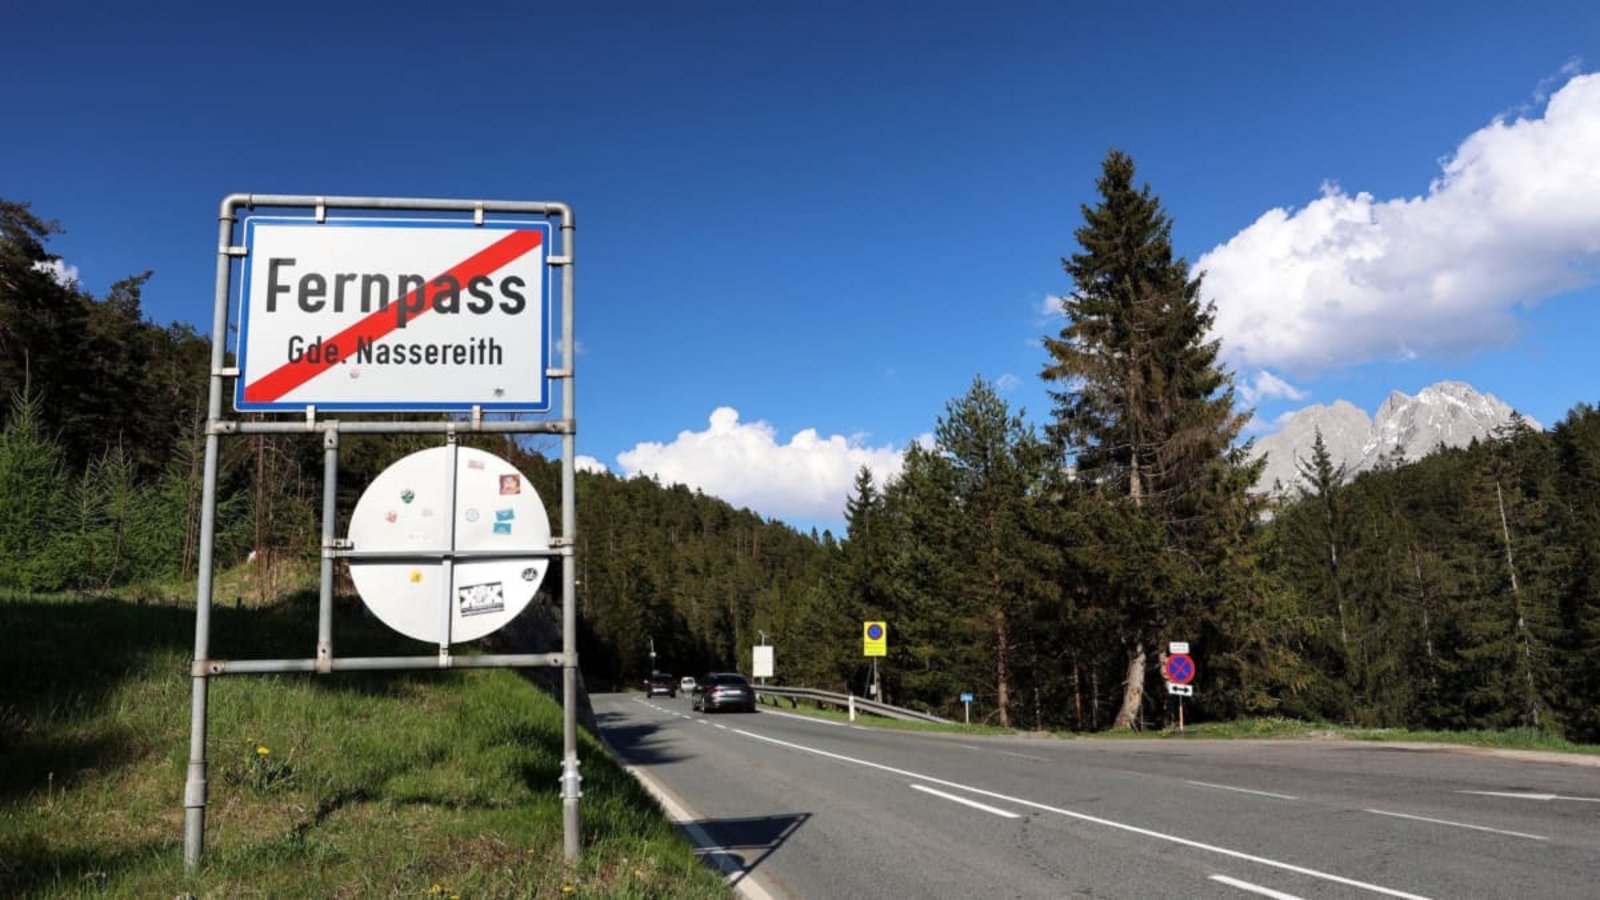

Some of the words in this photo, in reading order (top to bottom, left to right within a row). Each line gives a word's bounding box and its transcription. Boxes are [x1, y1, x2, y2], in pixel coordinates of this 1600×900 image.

[266, 258, 526, 328] Fernpass
[288, 335, 347, 364] Gde.
[356, 336, 503, 365] Nassereith
